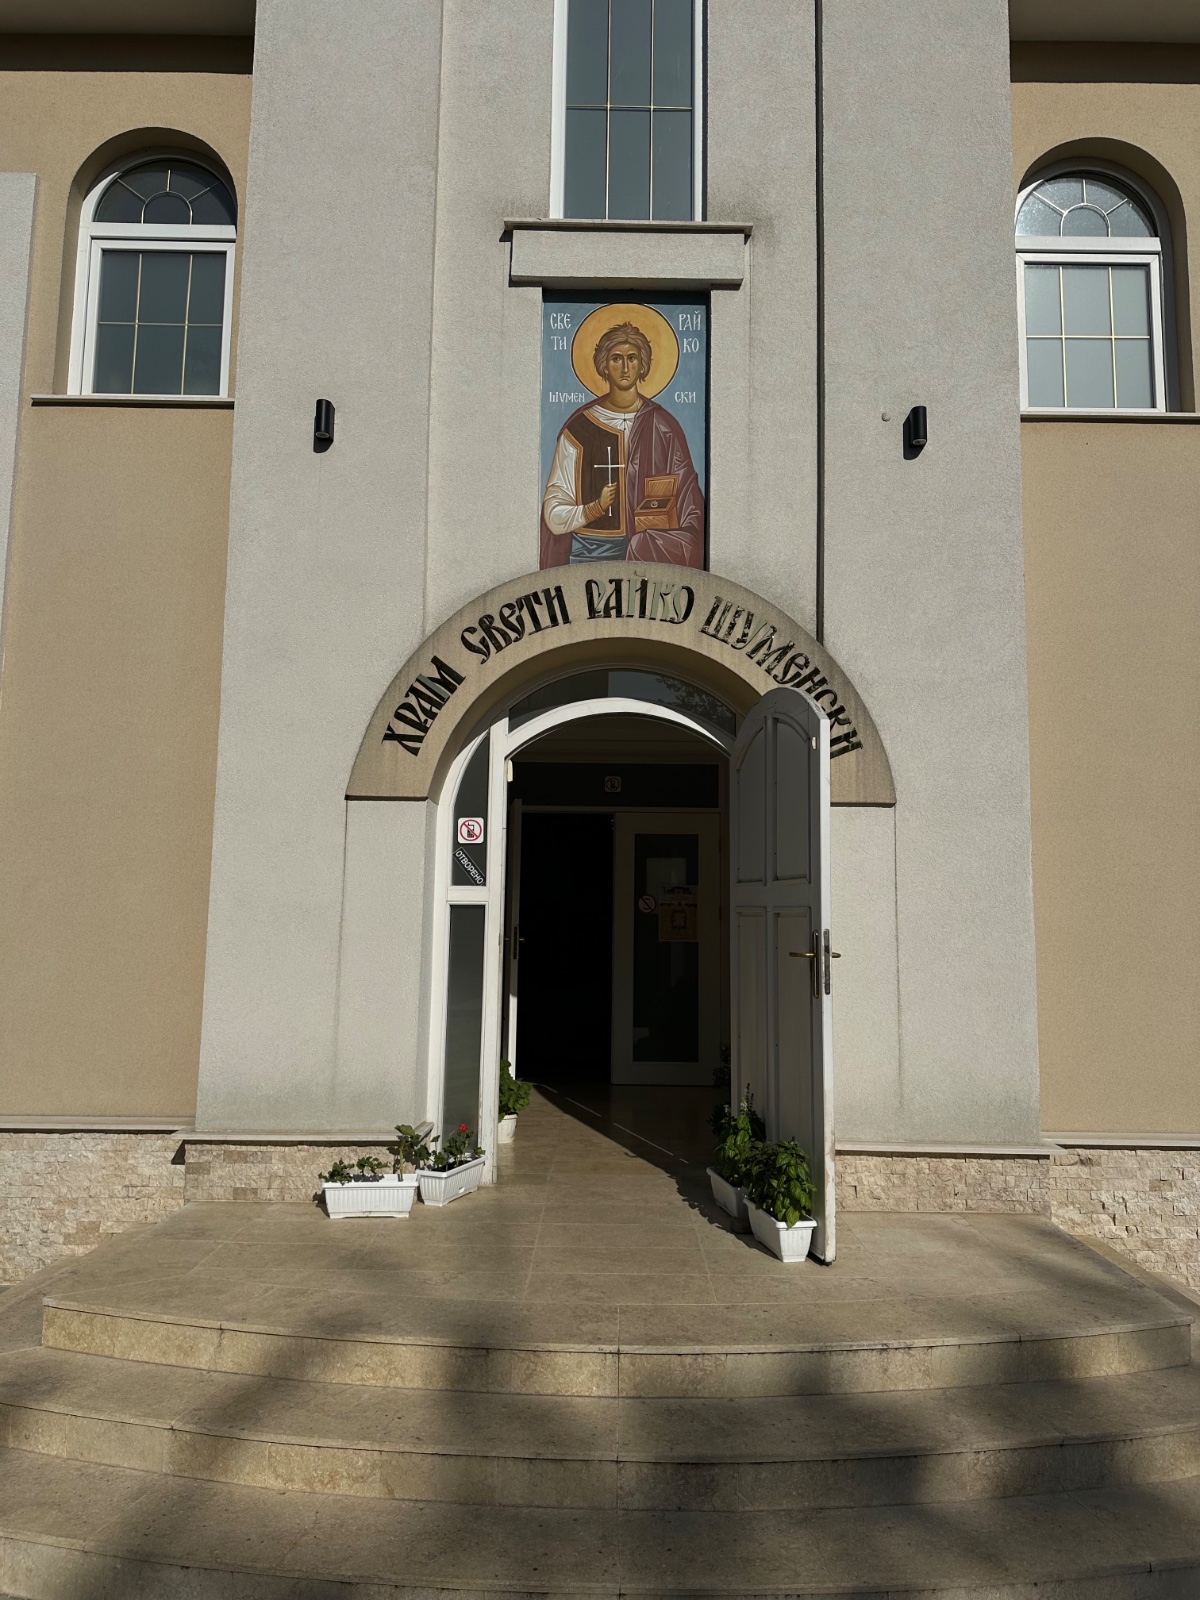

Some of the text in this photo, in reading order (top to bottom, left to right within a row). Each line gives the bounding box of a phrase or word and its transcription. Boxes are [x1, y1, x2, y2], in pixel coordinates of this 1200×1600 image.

[550, 312, 572, 330] СВЕ
[678, 310, 701, 331] РАЙ
[550, 335, 567, 351] ТИ
[683, 337, 700, 353] КО
[549, 391, 585, 406] ШУМЕН
[674, 391, 696, 403] СКИ
[381, 655, 466, 757] ХРАМ
[460, 585, 572, 665] СВЕТИ
[584, 570, 695, 625] РАЙКО
[455, 850, 484, 884] ОТВОРЕНО
